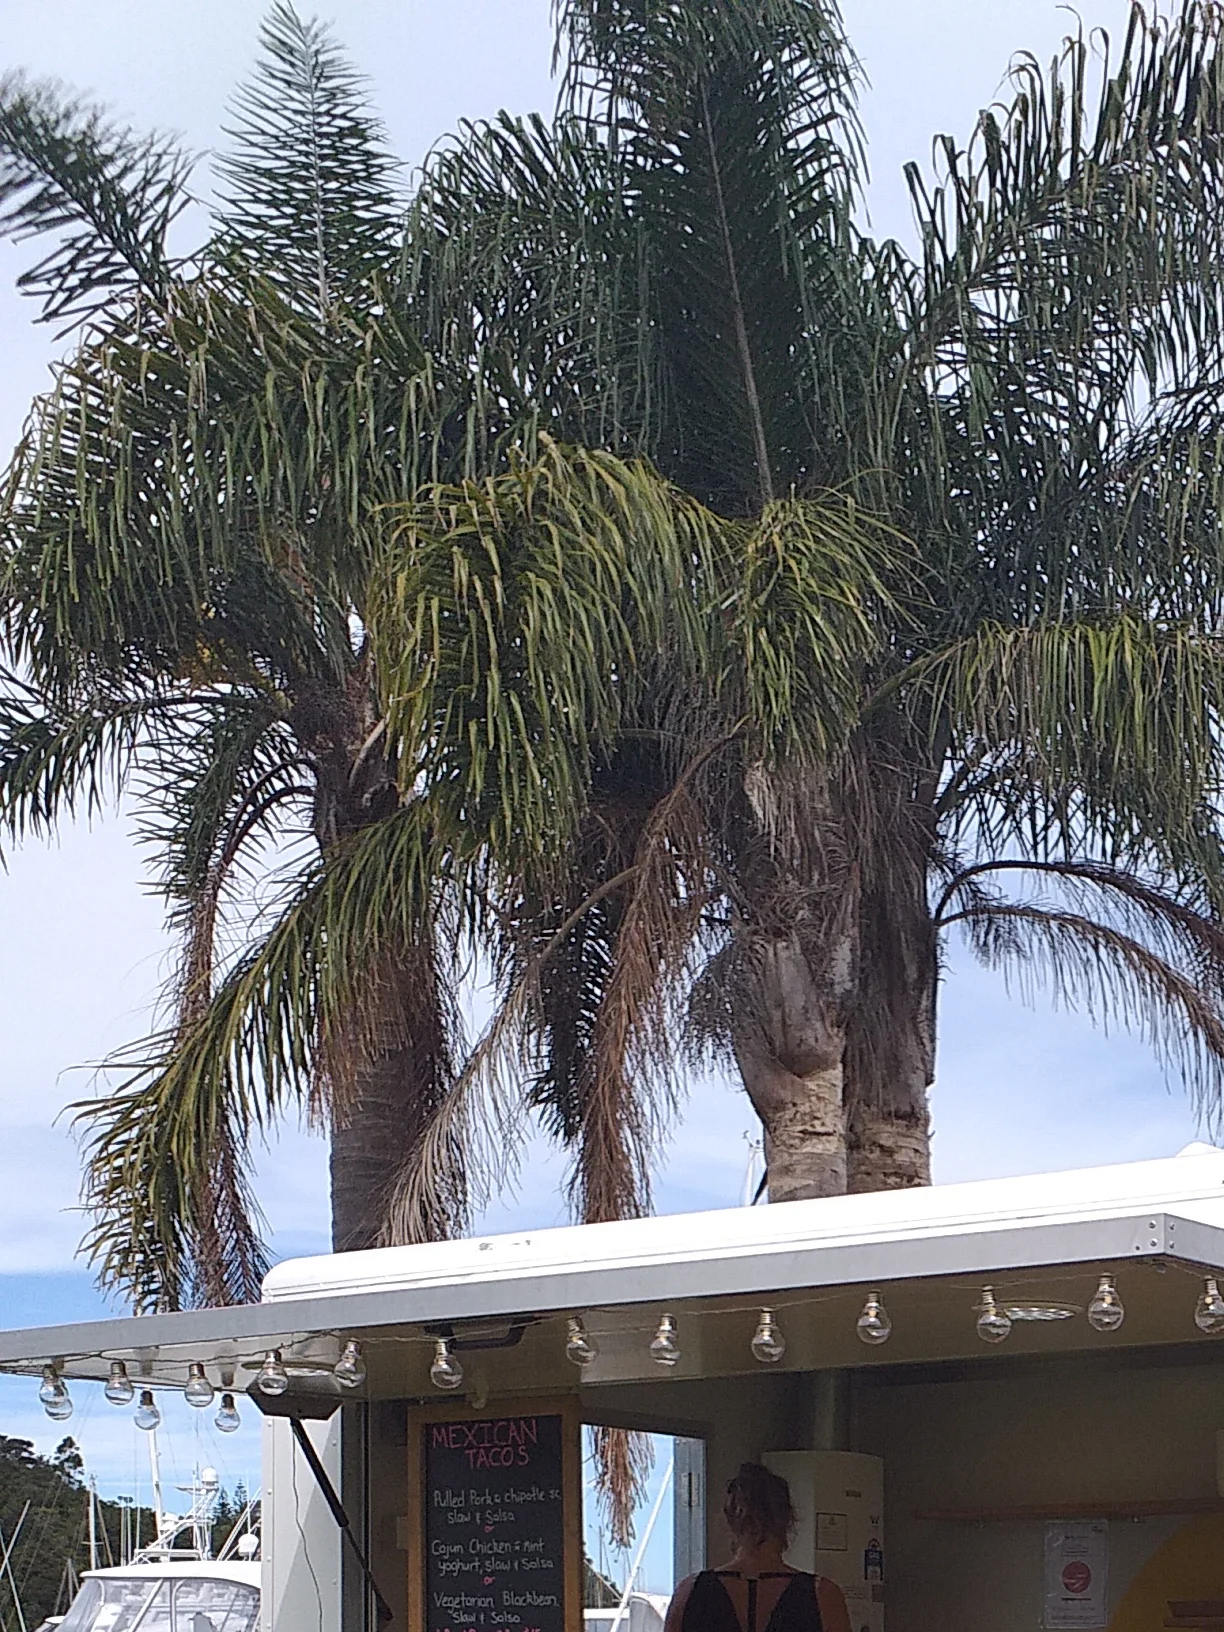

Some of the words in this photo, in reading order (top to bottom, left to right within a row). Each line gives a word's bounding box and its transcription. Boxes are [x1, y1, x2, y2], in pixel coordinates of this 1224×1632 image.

[432, 1419, 538, 1448] MEXICAN
[464, 1446, 530, 1469] TACOS
[433, 1489, 465, 1508] Pulled
[470, 1488, 493, 1506] Pork
[504, 1487, 545, 1504] chipotle
[485, 1508, 515, 1525] Salsa
[484, 1525, 495, 1533] or
[431, 1539, 463, 1559] Cajun
[469, 1538, 512, 1554] Chicken
[522, 1557, 554, 1570] Salsa
[484, 1576, 495, 1585] or
[433, 1592, 495, 1614] Vegetarian
